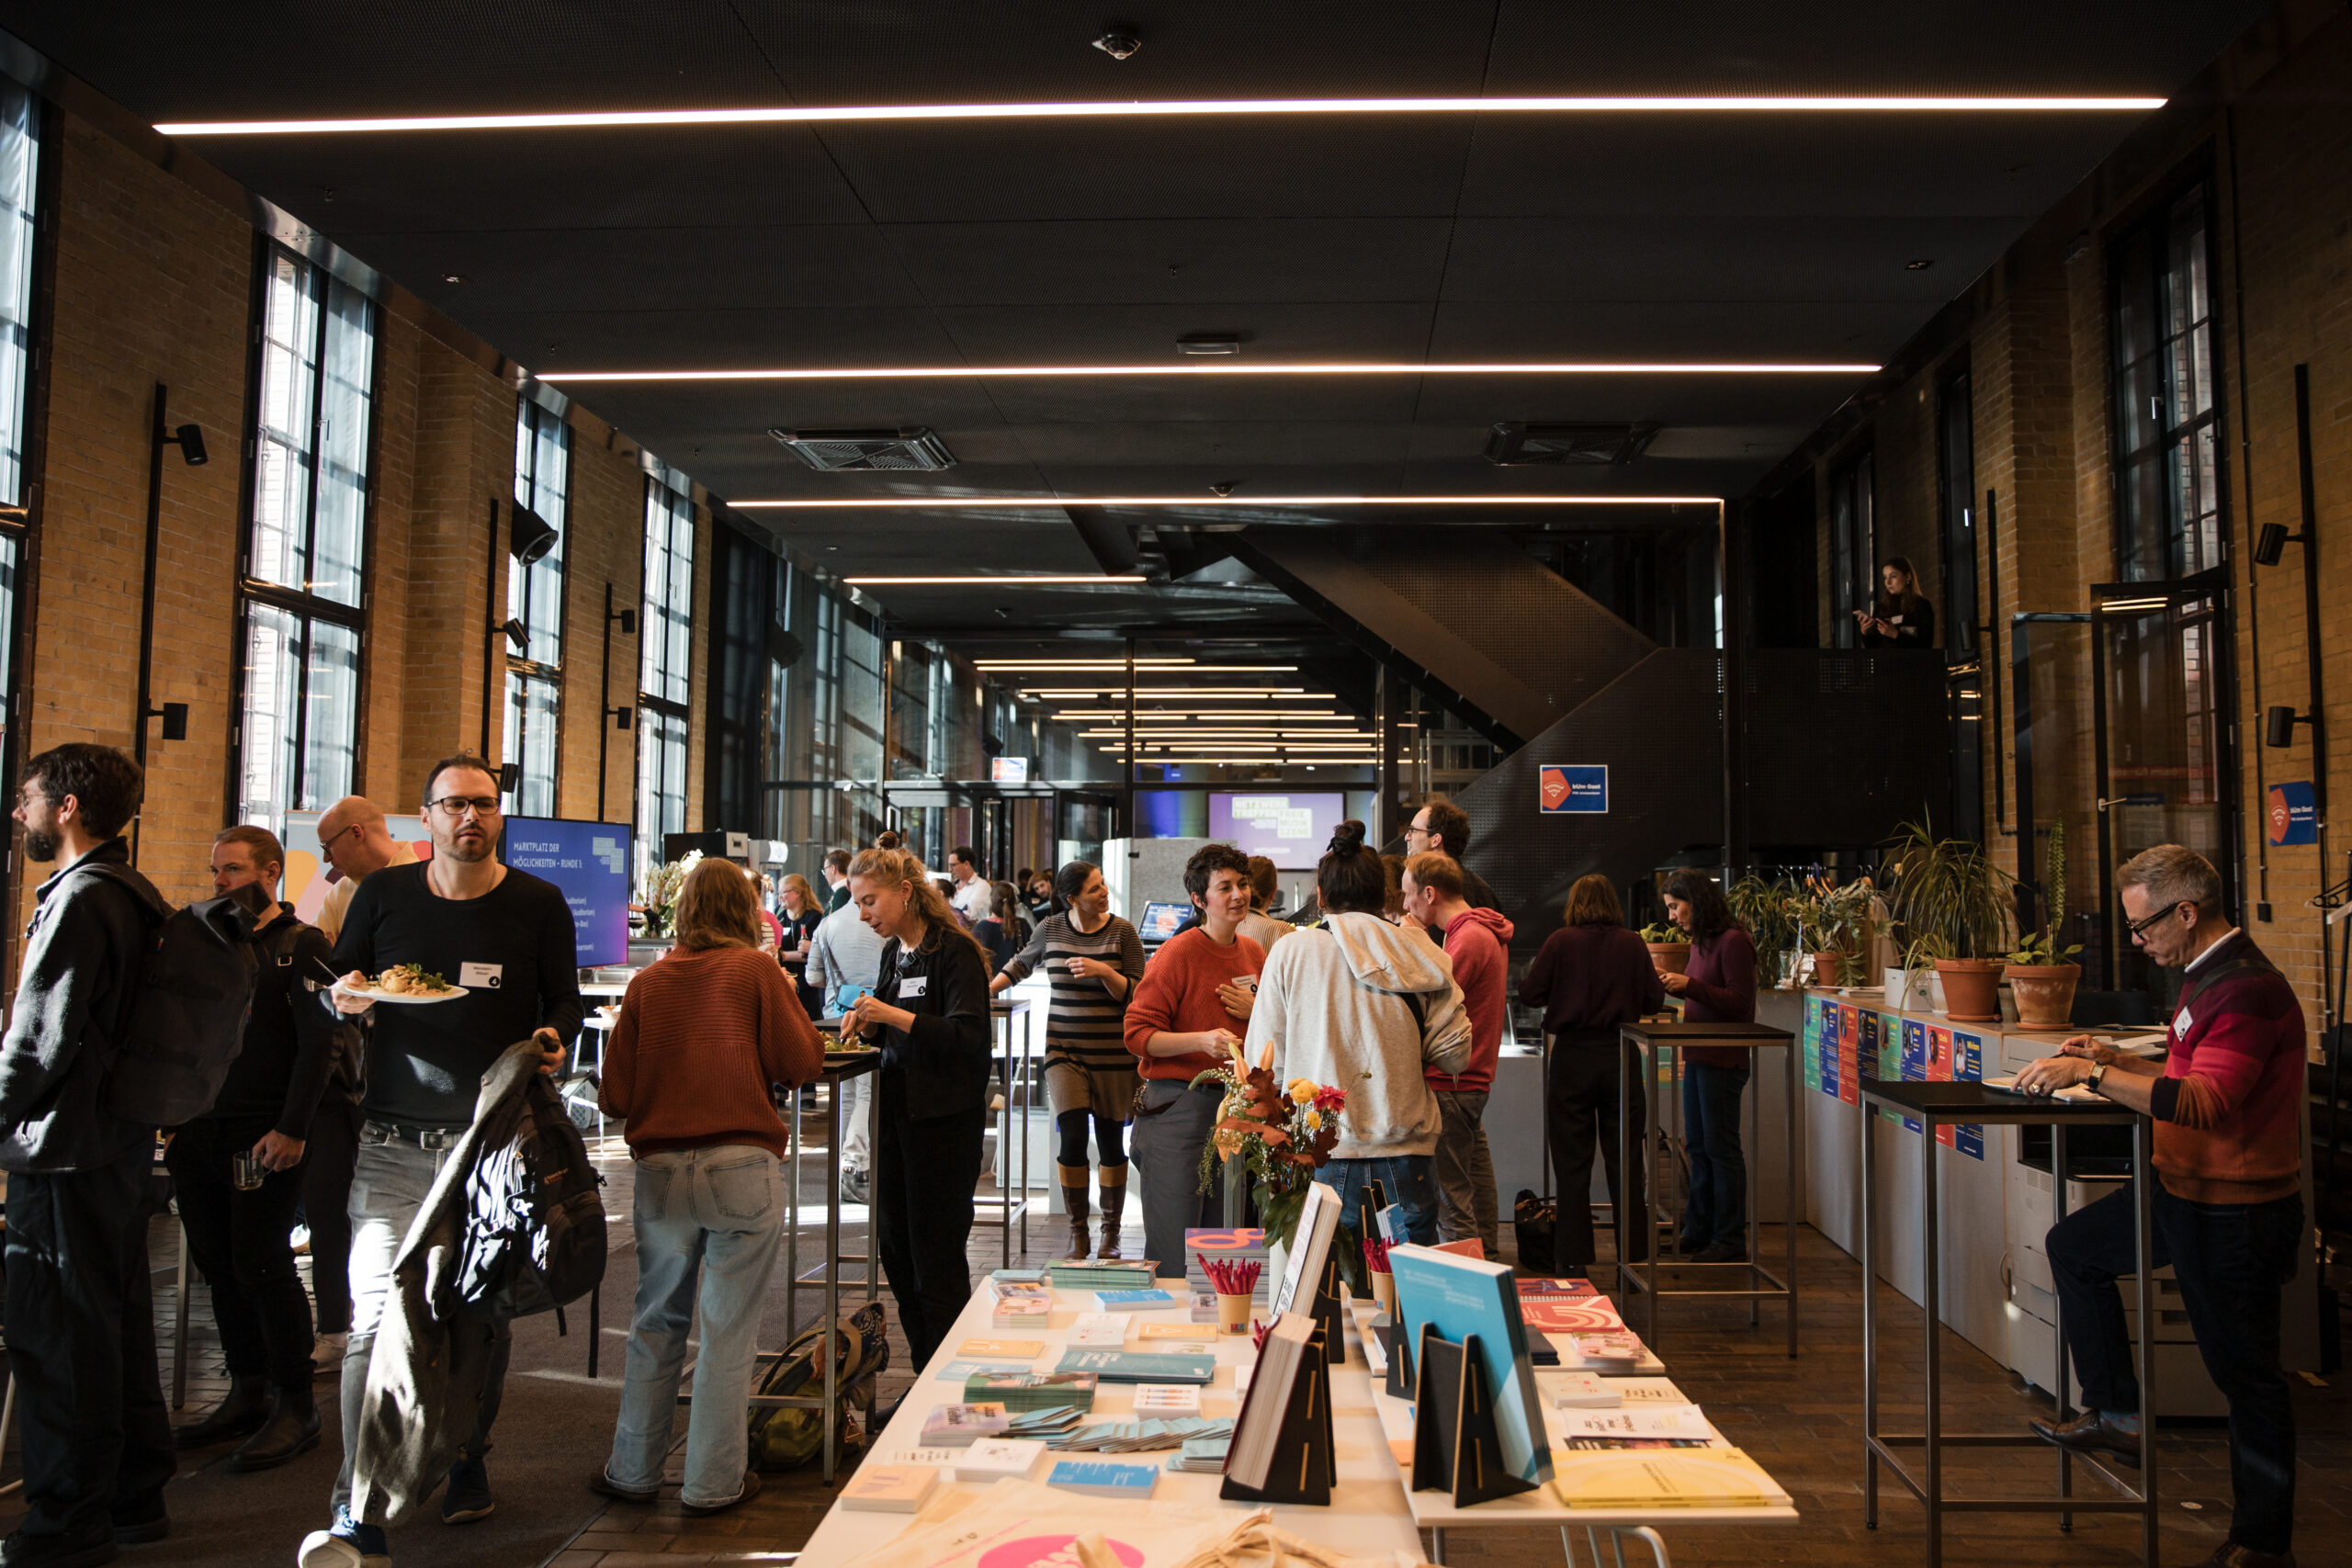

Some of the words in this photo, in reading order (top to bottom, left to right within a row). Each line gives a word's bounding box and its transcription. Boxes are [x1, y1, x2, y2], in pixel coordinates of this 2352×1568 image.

[514, 841, 548, 852] MARKTPLATZ
[548, 842, 560, 852] DER
[513, 855, 557, 868] MÖGLICHKEITEN
[560, 859, 578, 868] RUNDE
